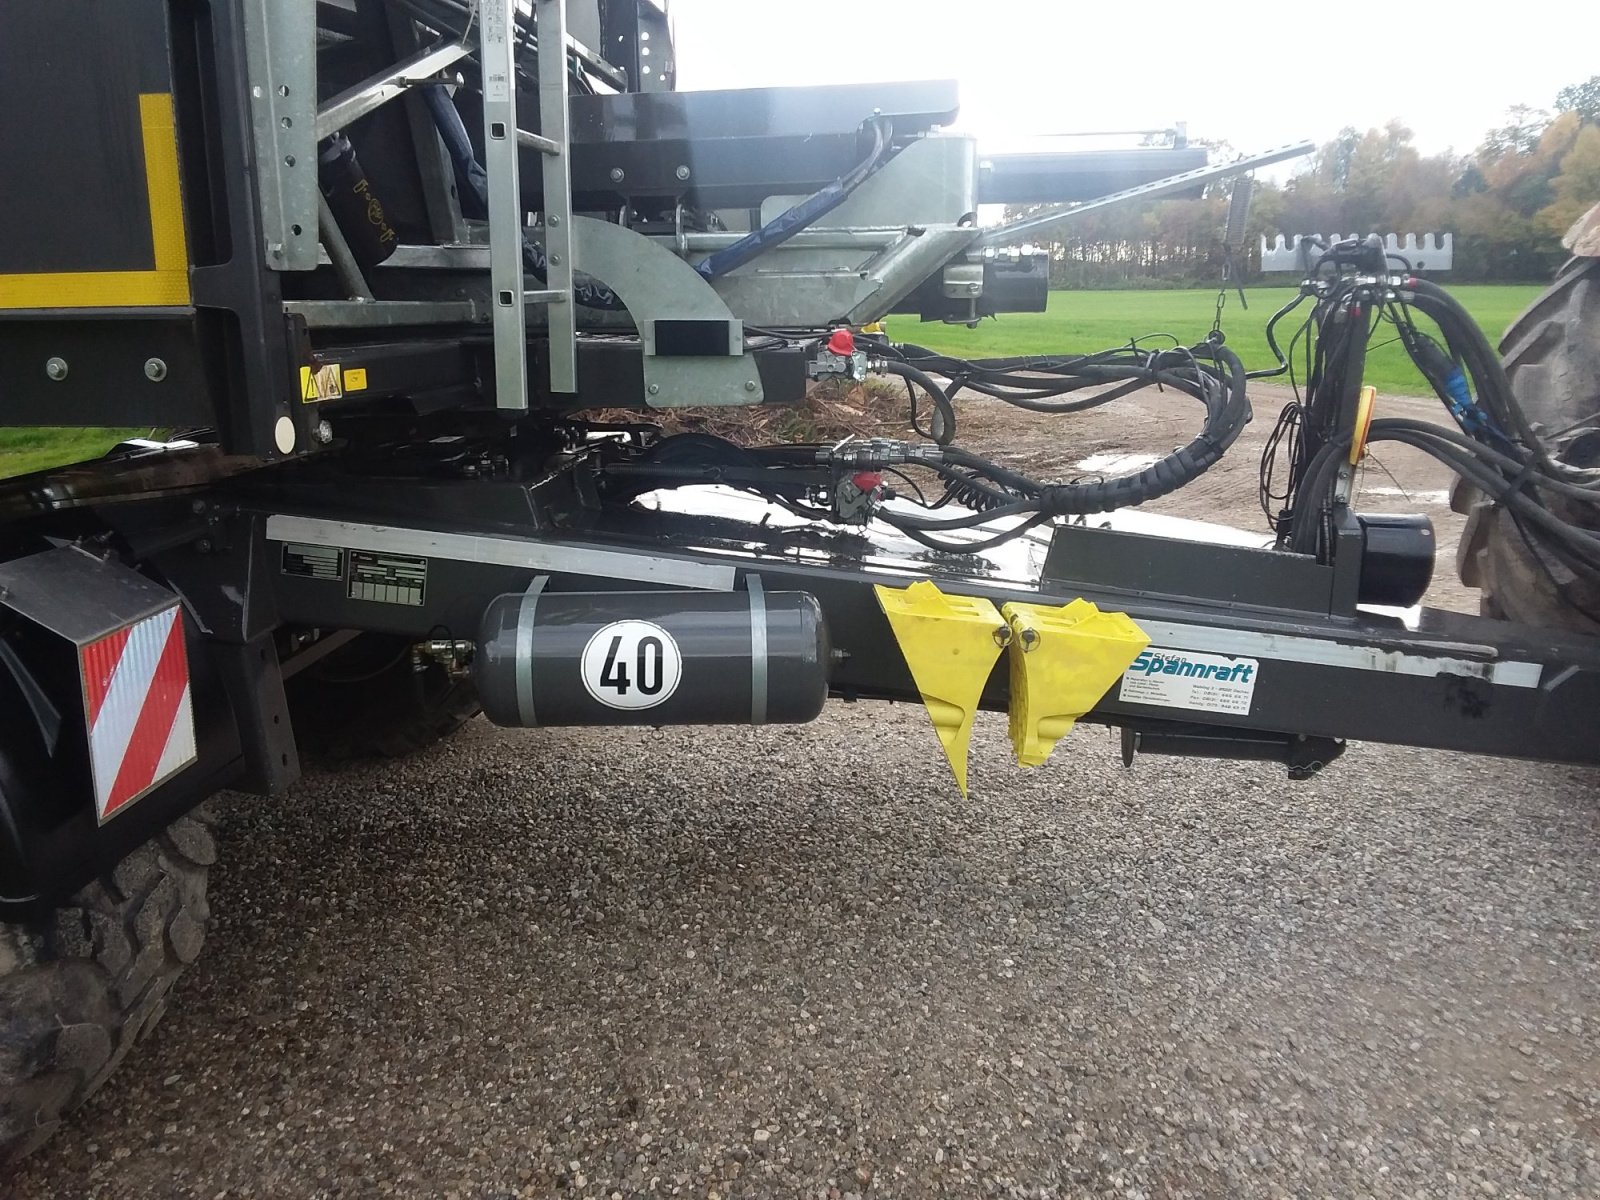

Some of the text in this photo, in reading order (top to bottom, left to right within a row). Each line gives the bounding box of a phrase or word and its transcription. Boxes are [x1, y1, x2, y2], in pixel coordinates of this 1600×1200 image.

[600, 636, 663, 695] 40
[1129, 652, 1254, 683] Spannraft
[1153, 652, 1187, 663] Stefan
